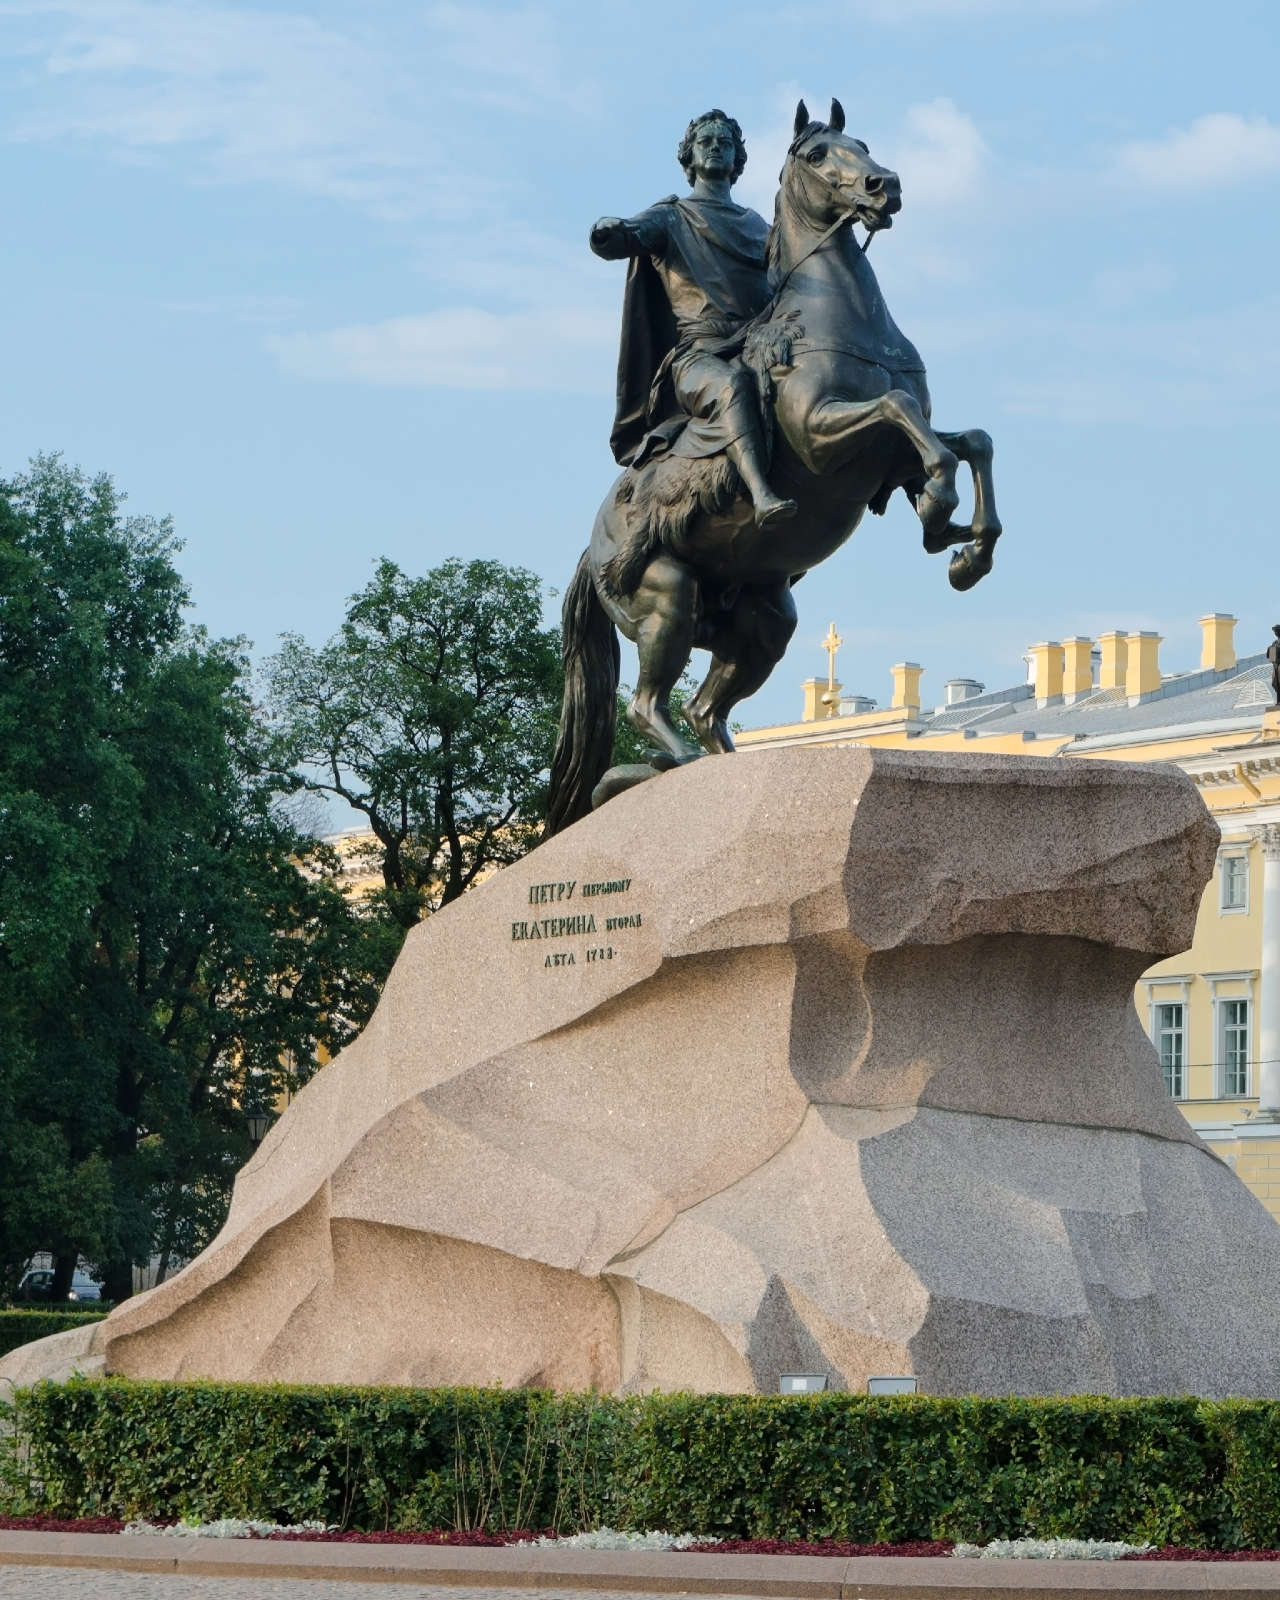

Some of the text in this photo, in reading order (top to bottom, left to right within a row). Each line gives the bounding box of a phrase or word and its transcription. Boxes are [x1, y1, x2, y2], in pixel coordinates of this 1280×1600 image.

[529, 881, 576, 904] ПЕТРУ
[512, 914, 642, 941] ЕКАТЕРИНА ВТОРАЯ
